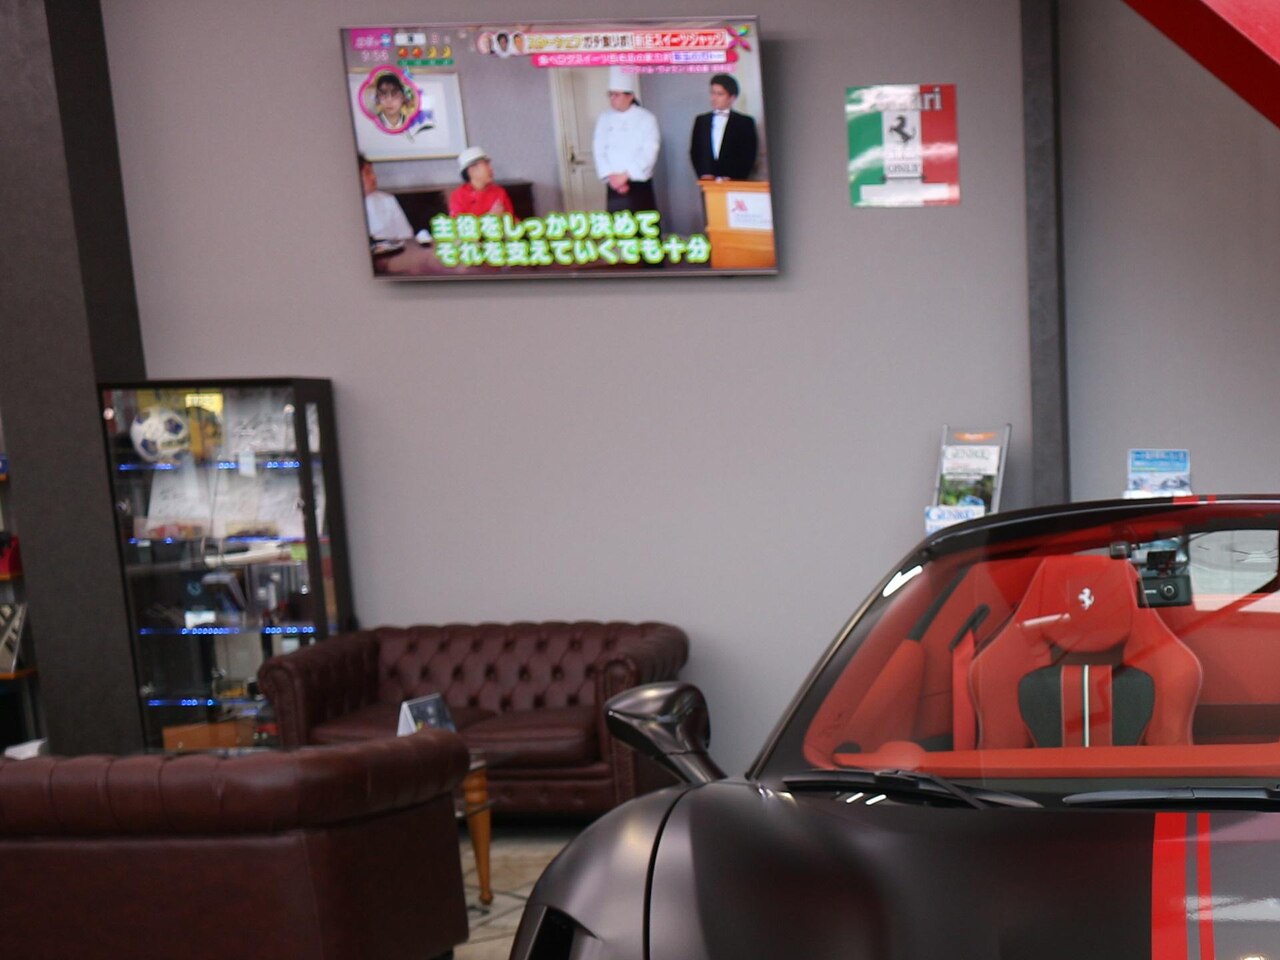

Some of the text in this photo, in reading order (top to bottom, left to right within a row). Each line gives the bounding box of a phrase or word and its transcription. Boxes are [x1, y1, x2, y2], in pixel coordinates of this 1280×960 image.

[431, 211, 660, 241] 主役をしっかり決めて
[436, 235, 711, 267] それを支えていくでも十分
